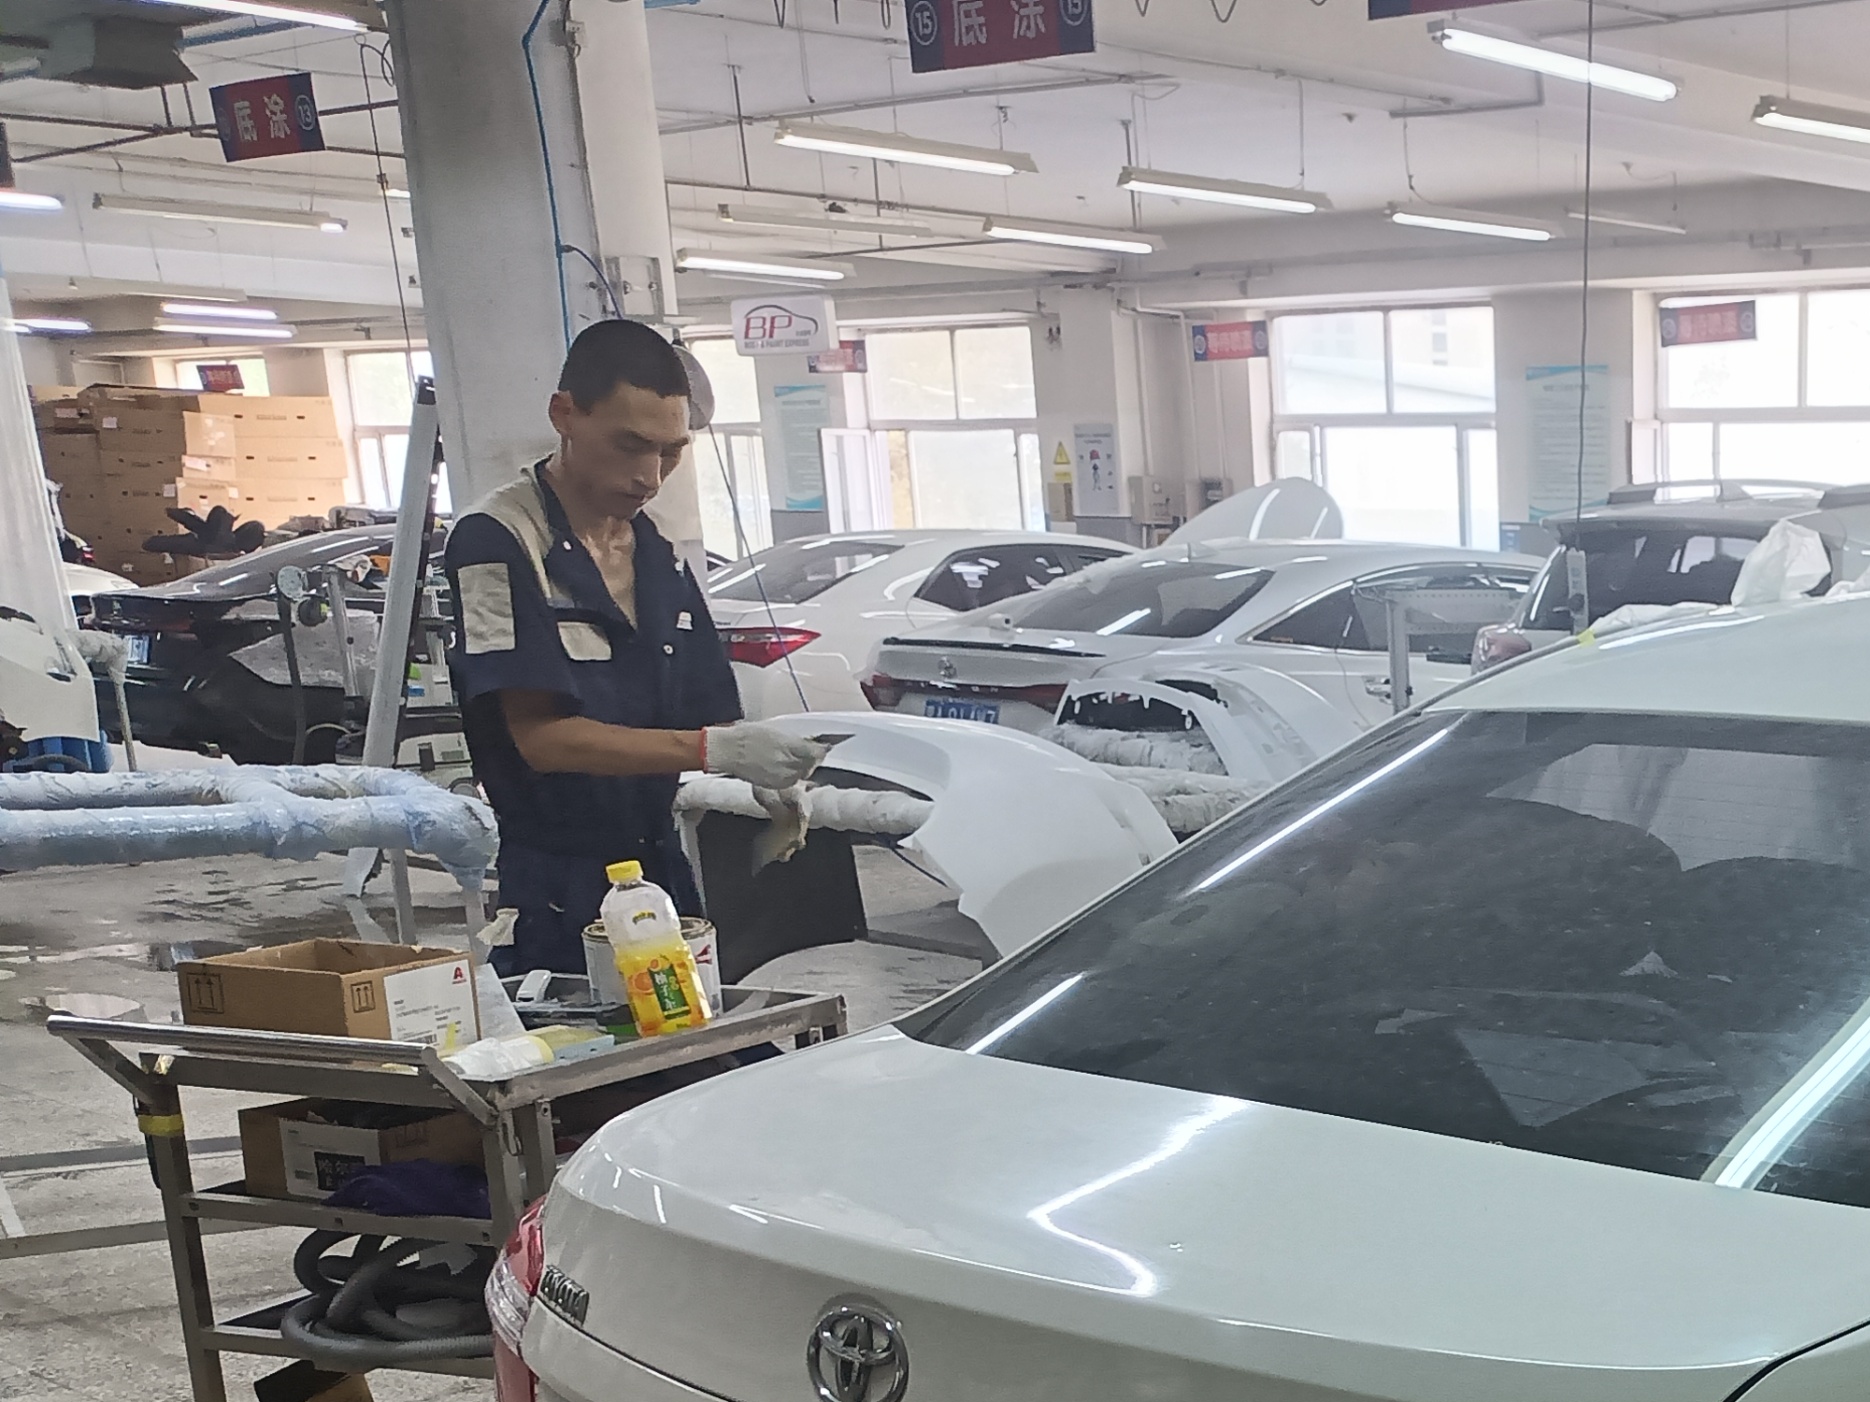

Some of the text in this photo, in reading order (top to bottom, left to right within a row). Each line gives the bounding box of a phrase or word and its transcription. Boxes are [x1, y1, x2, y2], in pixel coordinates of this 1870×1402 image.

[915, 12, 933, 36] 15
[953, 0, 1046, 47] 底涂
[744, 315, 792, 339] BP
